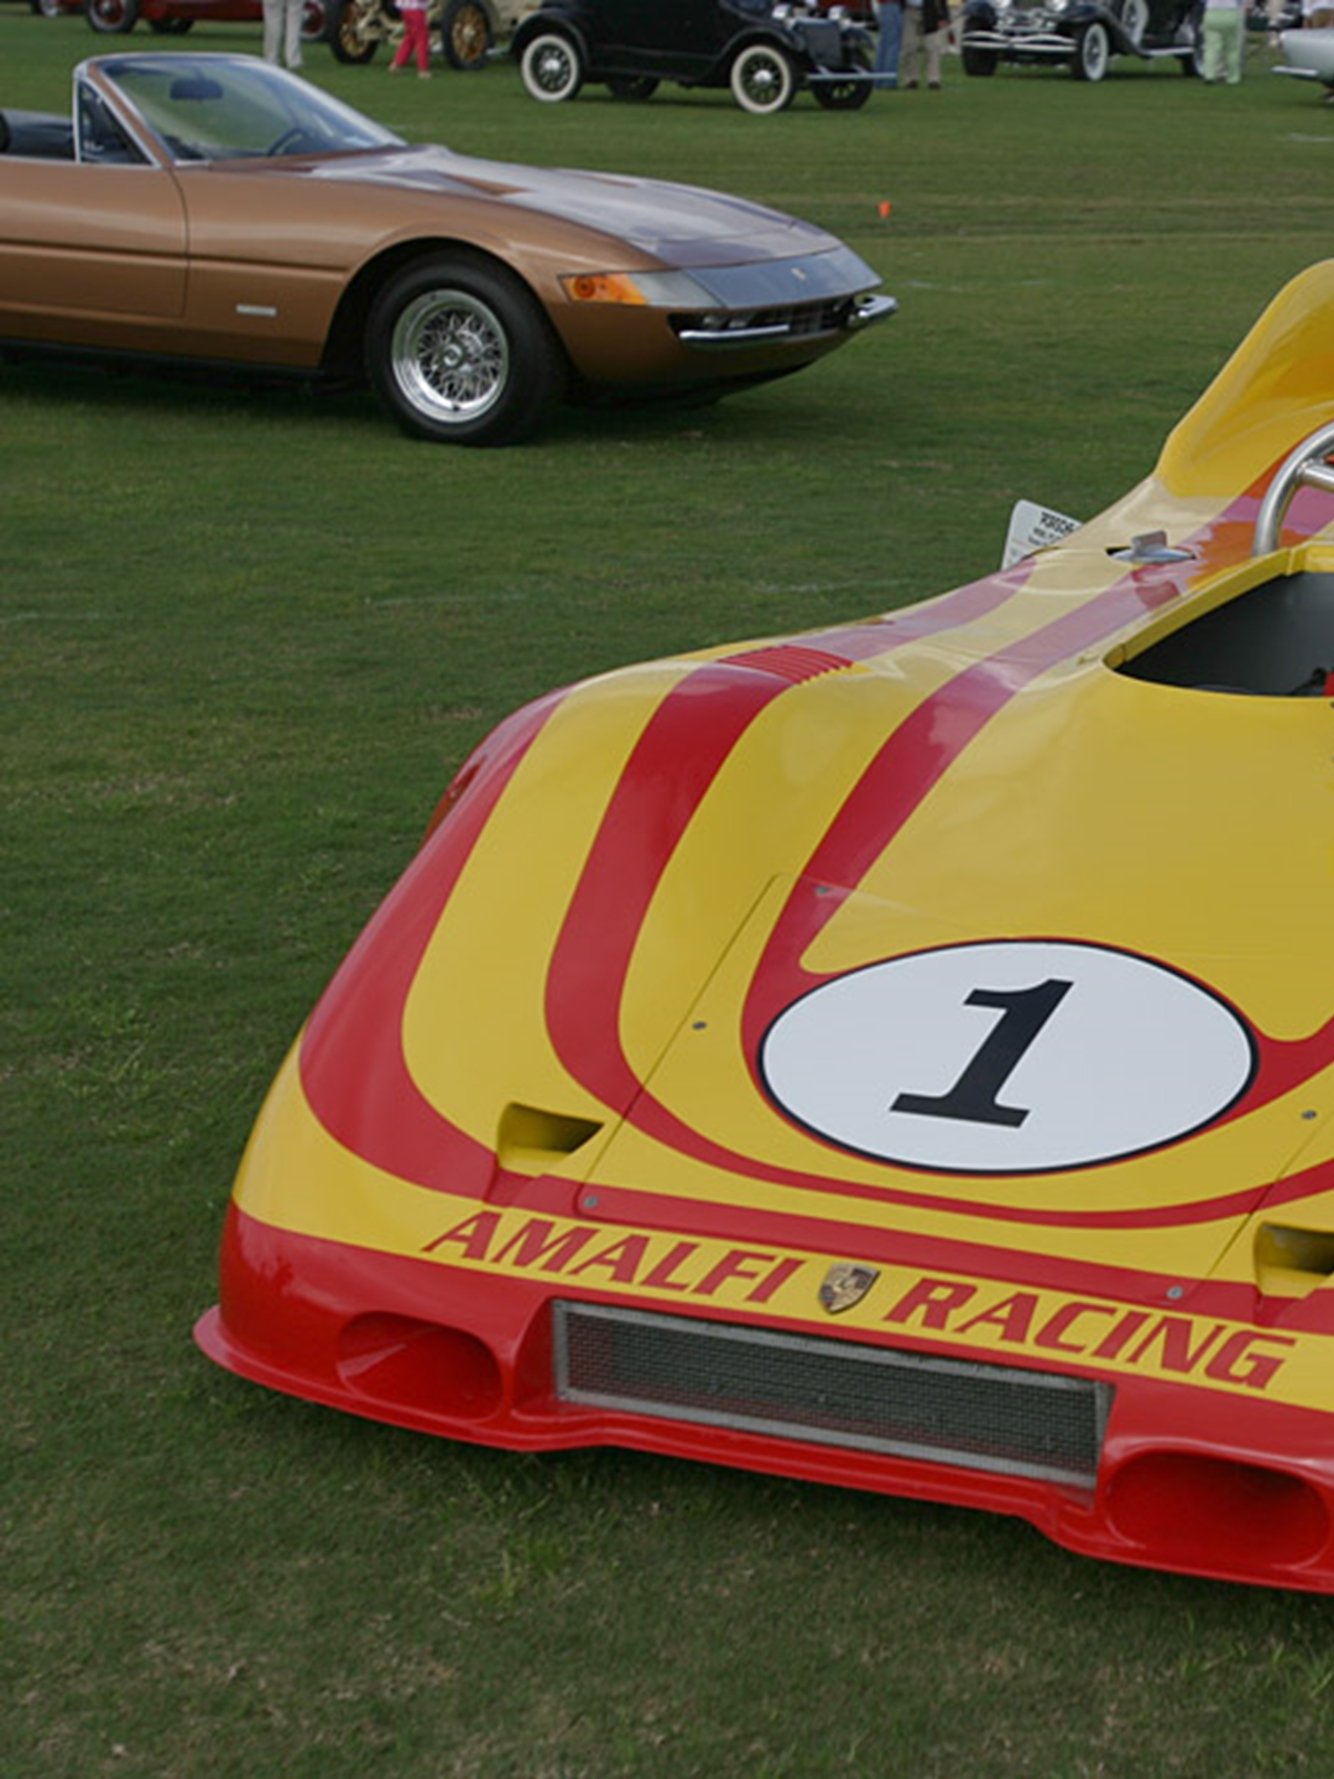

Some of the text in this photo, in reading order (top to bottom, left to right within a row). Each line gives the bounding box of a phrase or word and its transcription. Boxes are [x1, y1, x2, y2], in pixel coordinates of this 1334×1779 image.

[889, 978, 1075, 1129] 1
[421, 1210, 1297, 1390] AMALFI RACING
